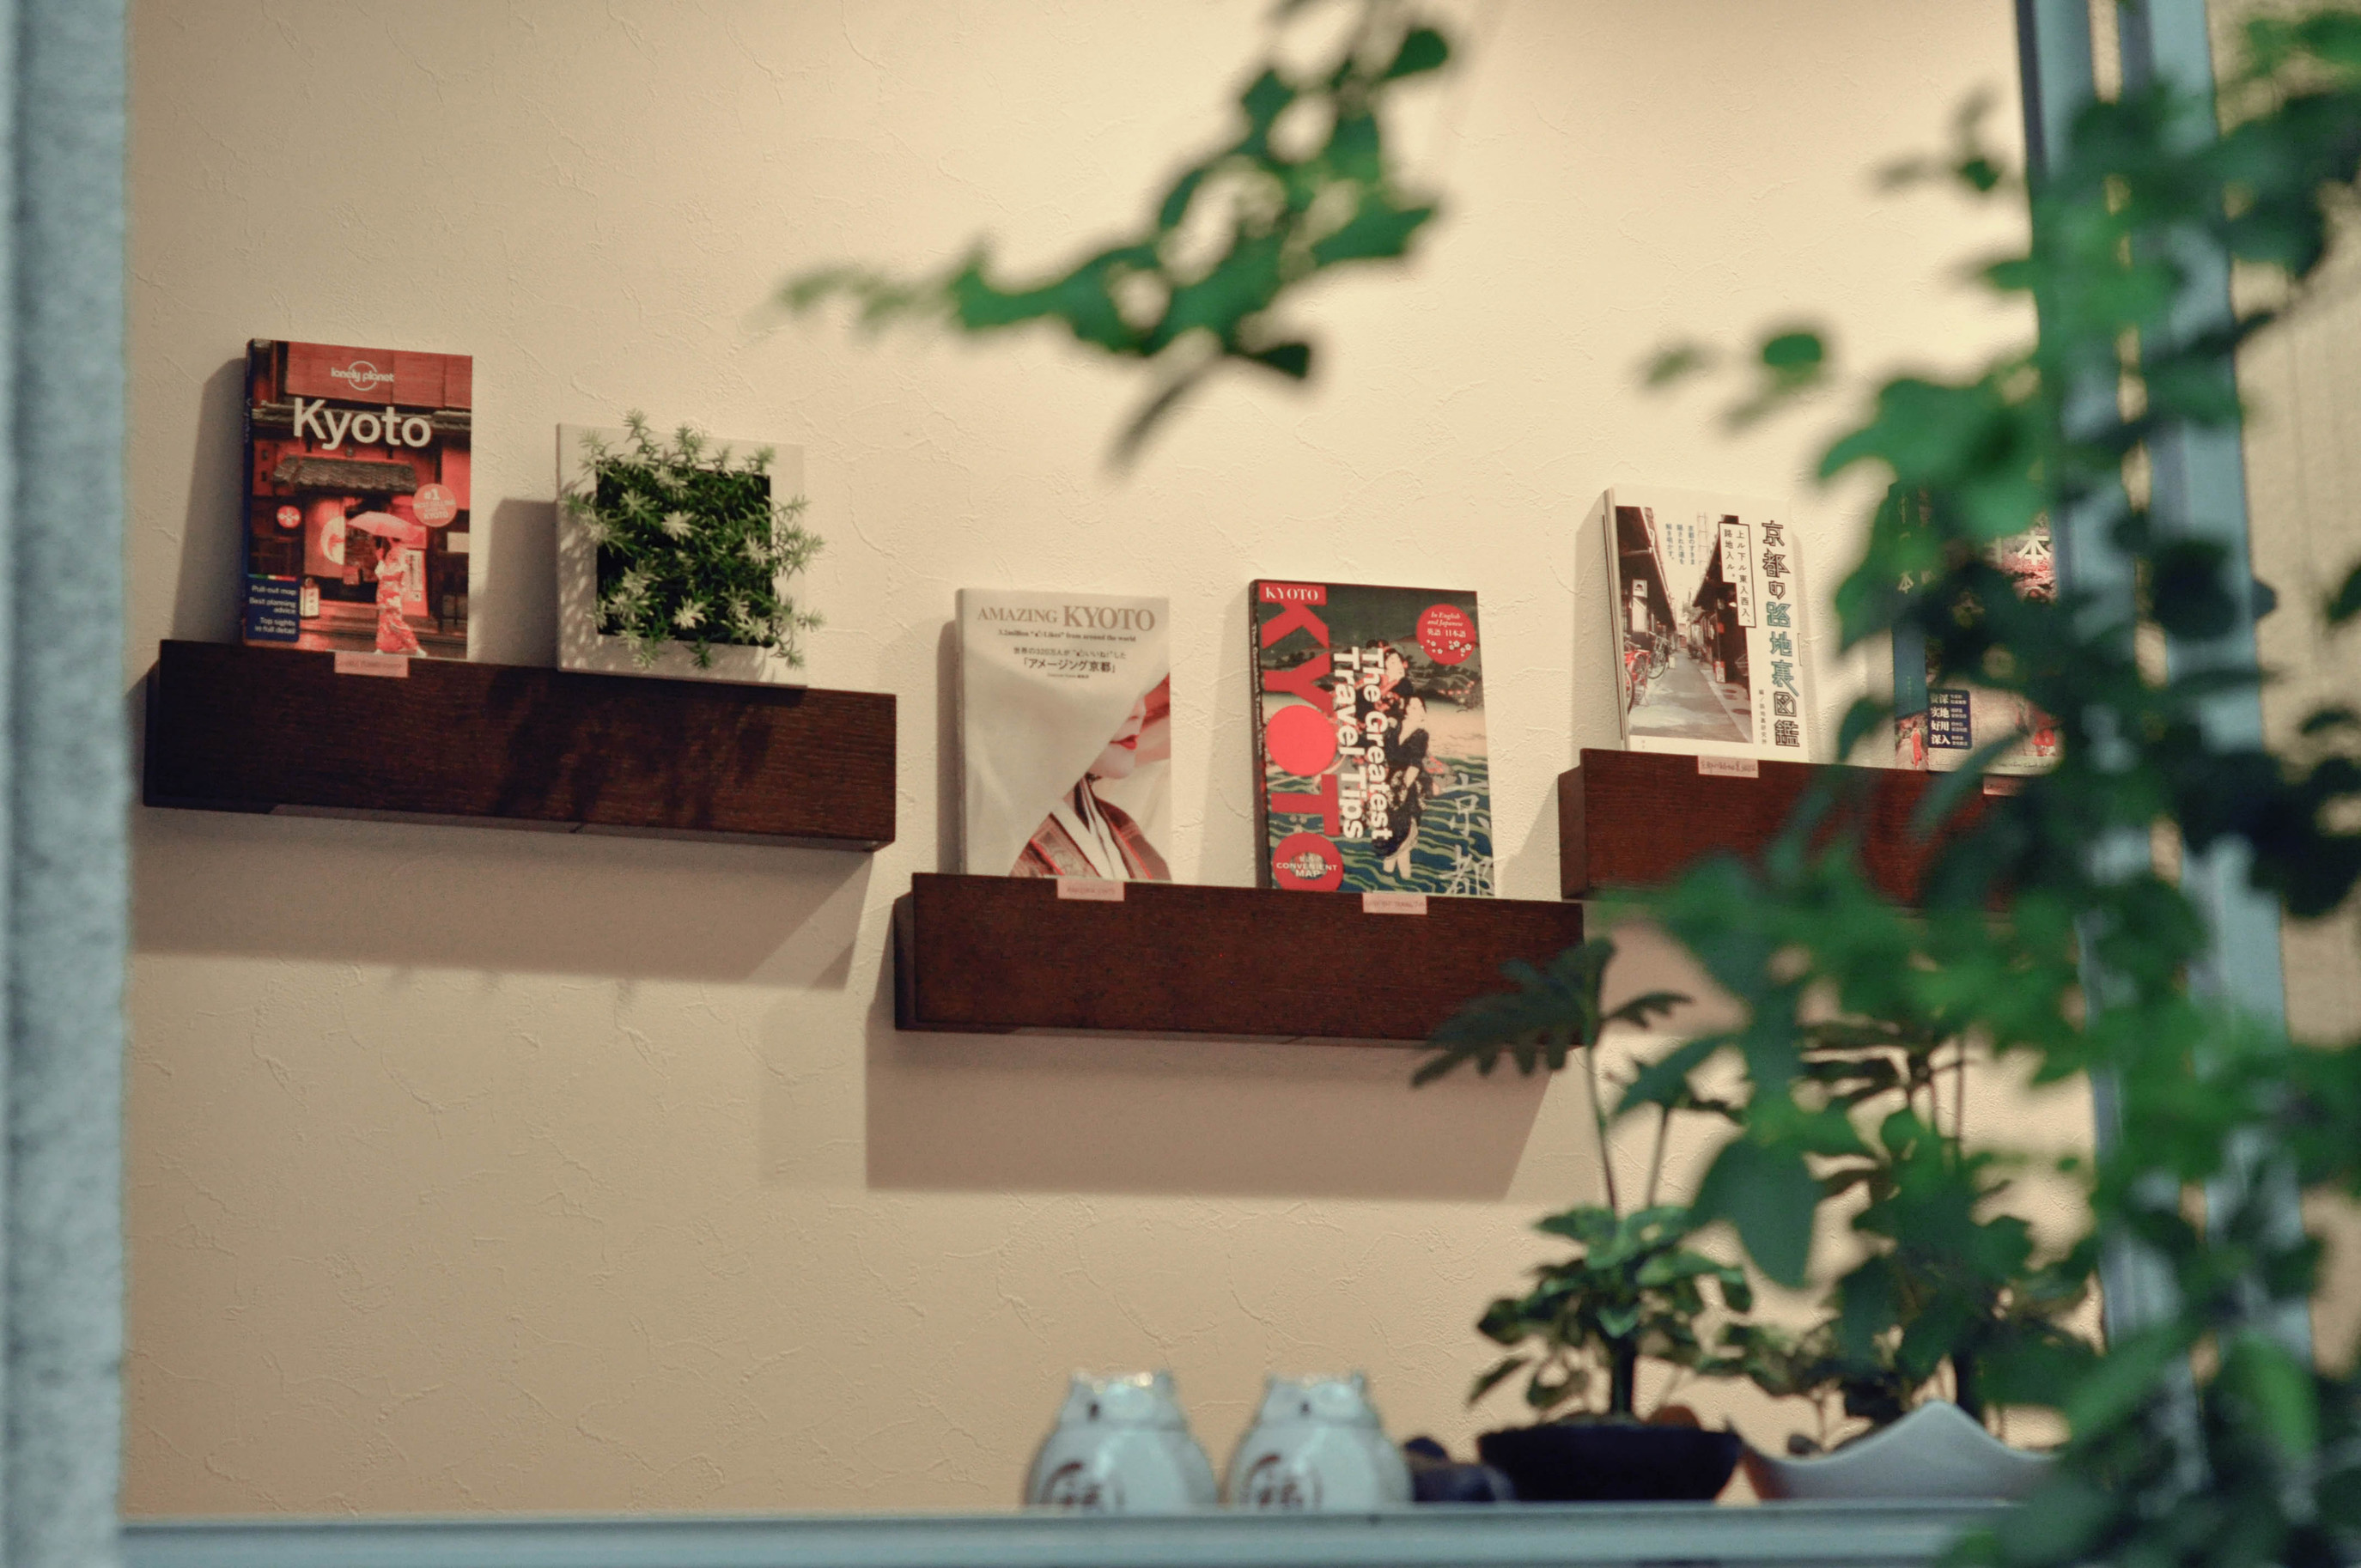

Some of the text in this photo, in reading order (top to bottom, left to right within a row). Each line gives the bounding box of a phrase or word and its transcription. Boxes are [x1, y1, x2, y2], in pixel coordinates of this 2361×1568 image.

[331, 367, 394, 382] lonely planet
[294, 398, 431, 451] Kyoto
[1266, 586, 1318, 600] KYOTO
[977, 605, 1155, 631] AMAZING KYOTO
[1762, 520, 1801, 748] 京都の路地裏図鑑
[1333, 646, 1367, 839] Travel Tips
[1362, 647, 1393, 840] The Greatest
[1295, 869, 1320, 878] MAP
